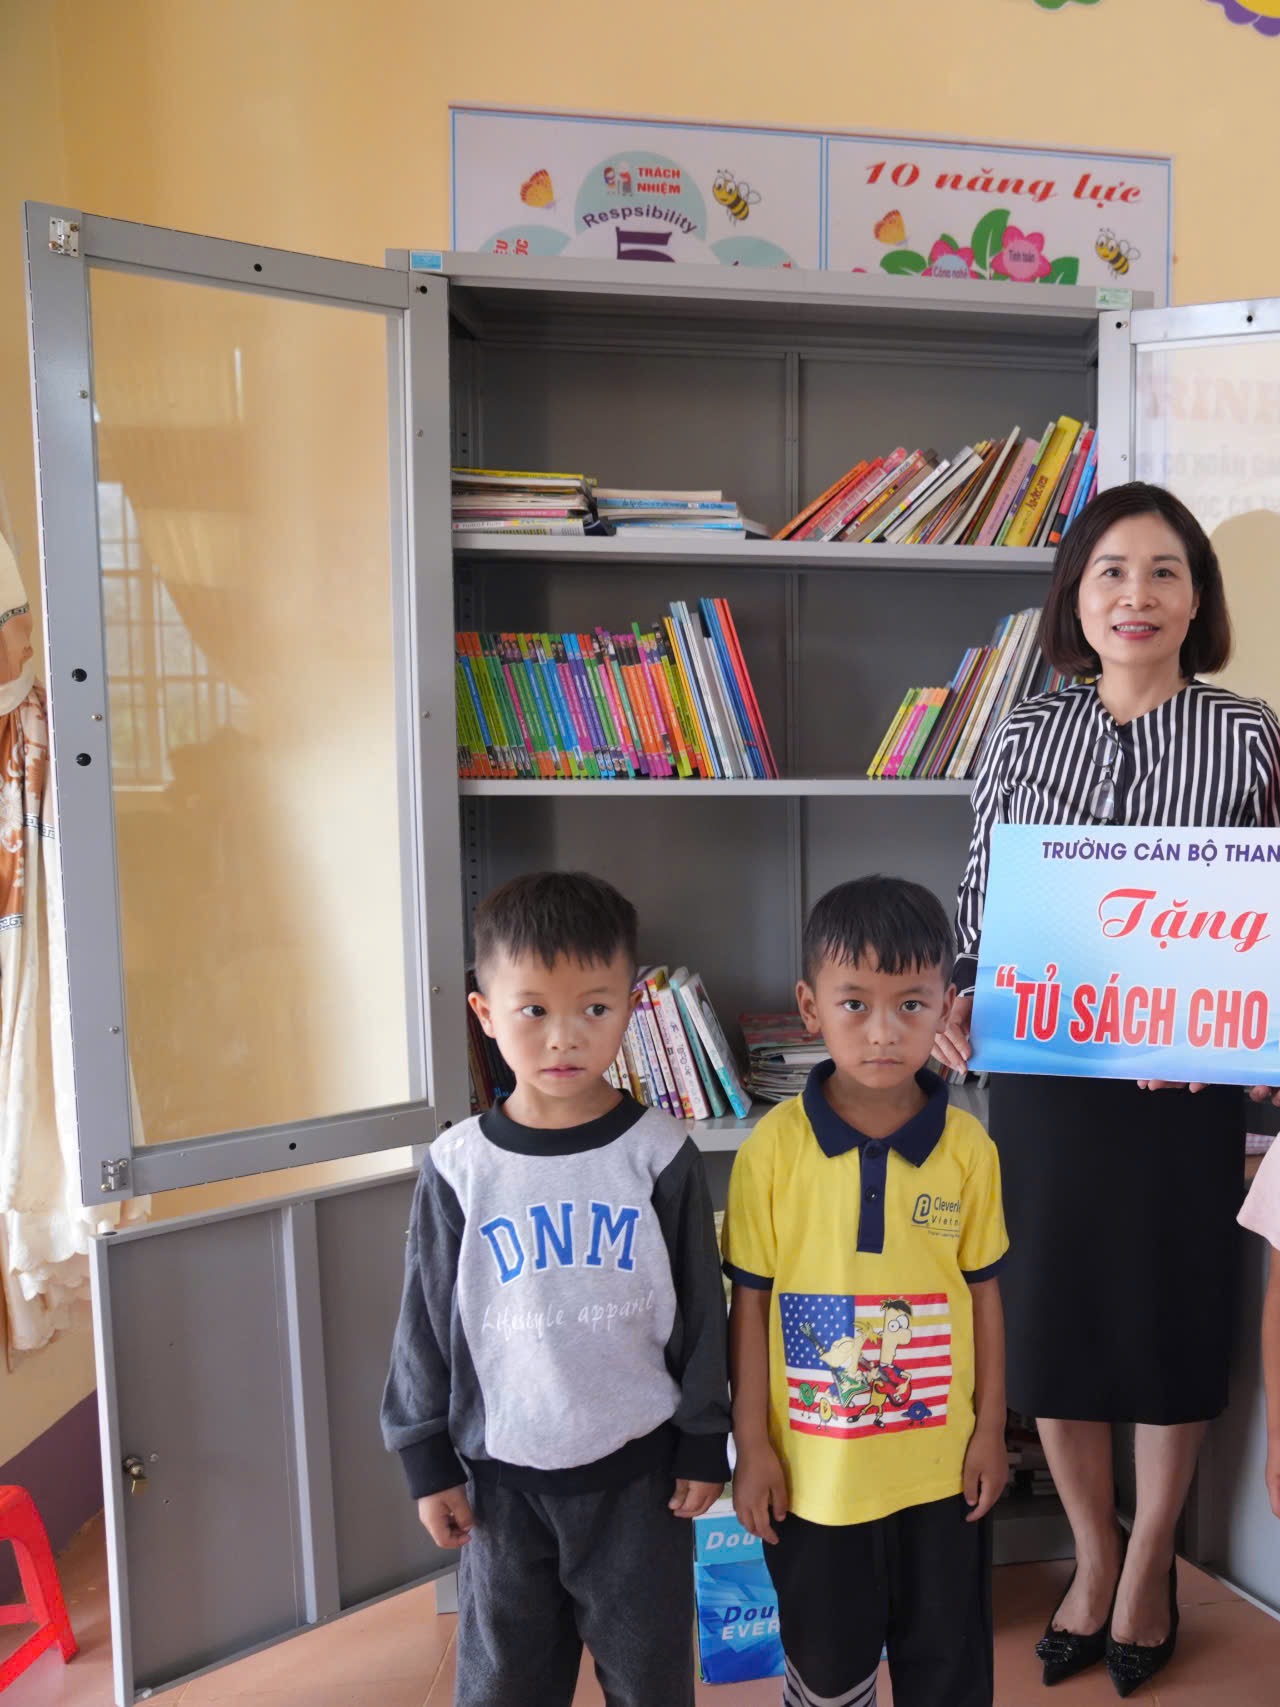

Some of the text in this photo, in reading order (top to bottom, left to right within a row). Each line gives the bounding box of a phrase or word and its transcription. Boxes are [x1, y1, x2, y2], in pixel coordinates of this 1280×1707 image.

[637, 166, 680, 179] TRÁCH
[865, 161, 1142, 208] 10 năng lực
[637, 182, 681, 196] NHIỆM
[582, 204, 697, 234] Respsibility
[1042, 838, 1127, 861] TRƯỜNG
[1133, 839, 1180, 861] CÁN
[1188, 840, 1218, 867] BỘ
[1098, 888, 1271, 953] Tặng
[1069, 973, 1177, 1047] SÁCH
[1187, 988, 1269, 1051] CHO
[934, 1196, 960, 1213] Cleverl
[931, 1215, 959, 1226] Vietn
[479, 1200, 642, 1286] DNM
[481, 1290, 654, 1341] Lifestyle apparel
[705, 1531, 763, 1550] Dou
[723, 1606, 778, 1625] Dou
[722, 1619, 781, 1641] EVER
